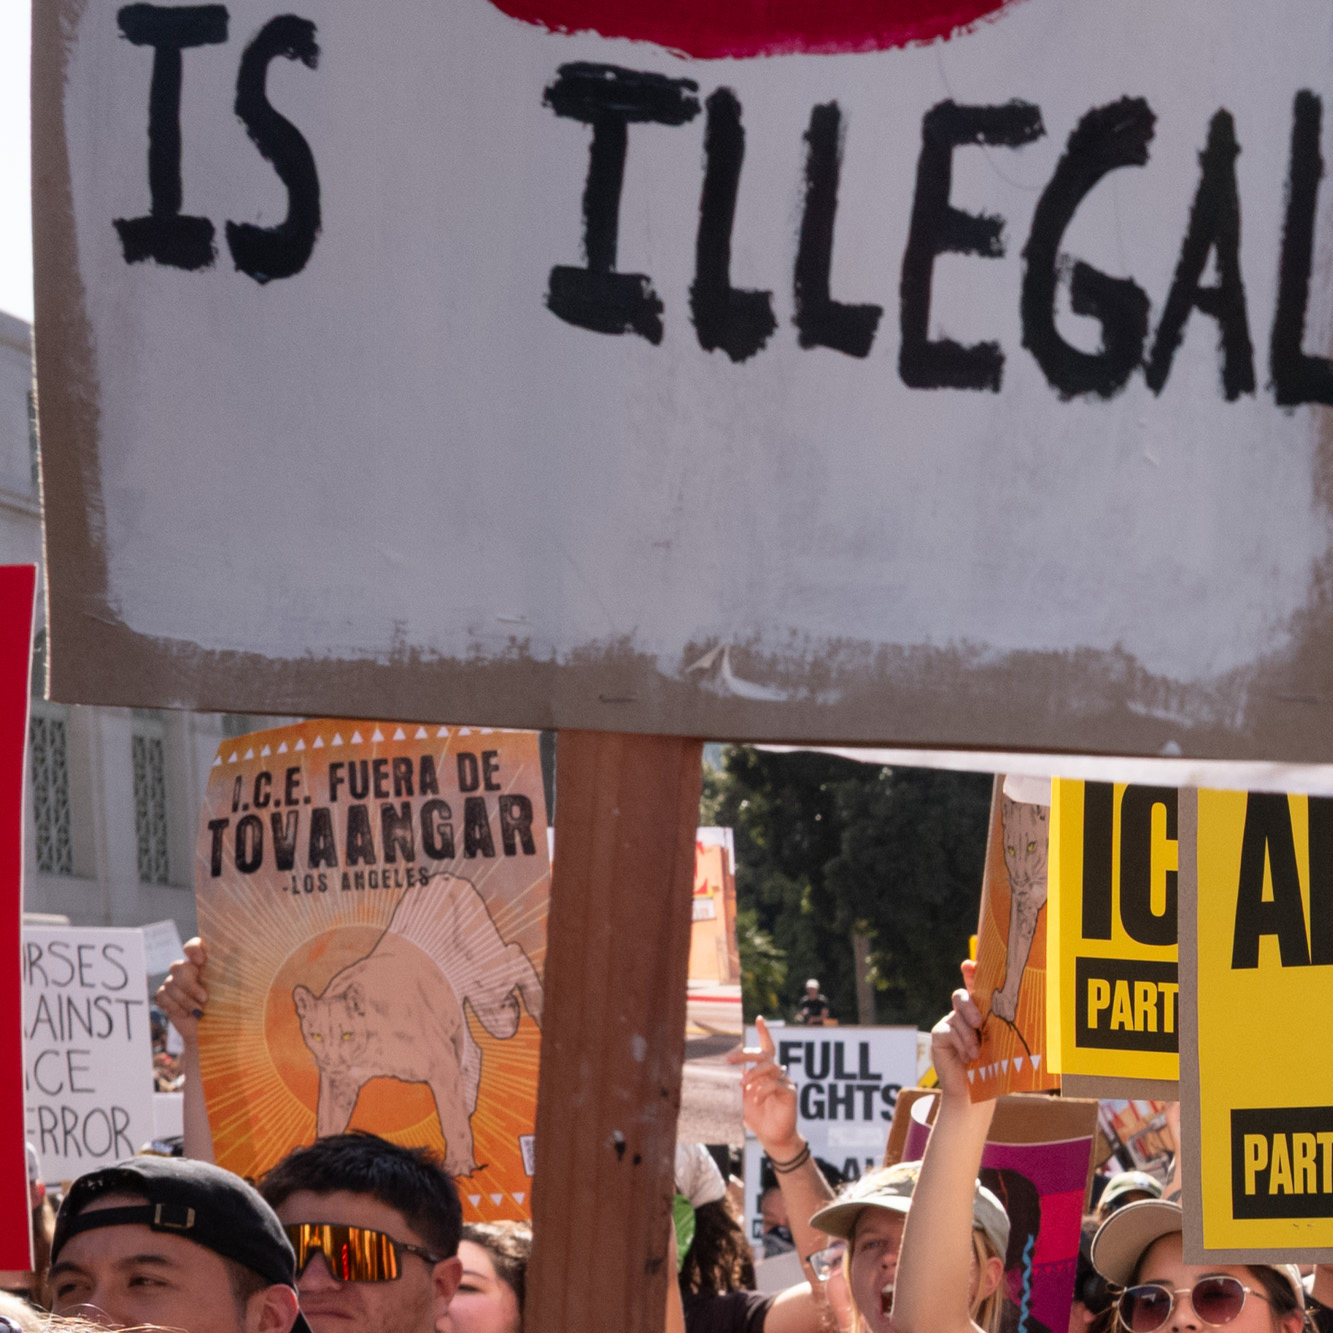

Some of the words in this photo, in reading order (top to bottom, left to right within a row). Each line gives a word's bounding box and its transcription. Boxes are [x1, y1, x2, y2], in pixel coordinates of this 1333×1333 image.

[114, 3, 321, 284] IS
[231, 766, 312, 813] I.C.E.
[329, 754, 440, 803] FUERA
[456, 749, 502, 793] DE
[207, 793, 537, 878] TOVAANGAR
[24, 941, 129, 992] RSES
[24, 994, 143, 1043] AINST
[779, 1040, 883, 1082] FULL
[796, 1081, 903, 1122] GHTS
